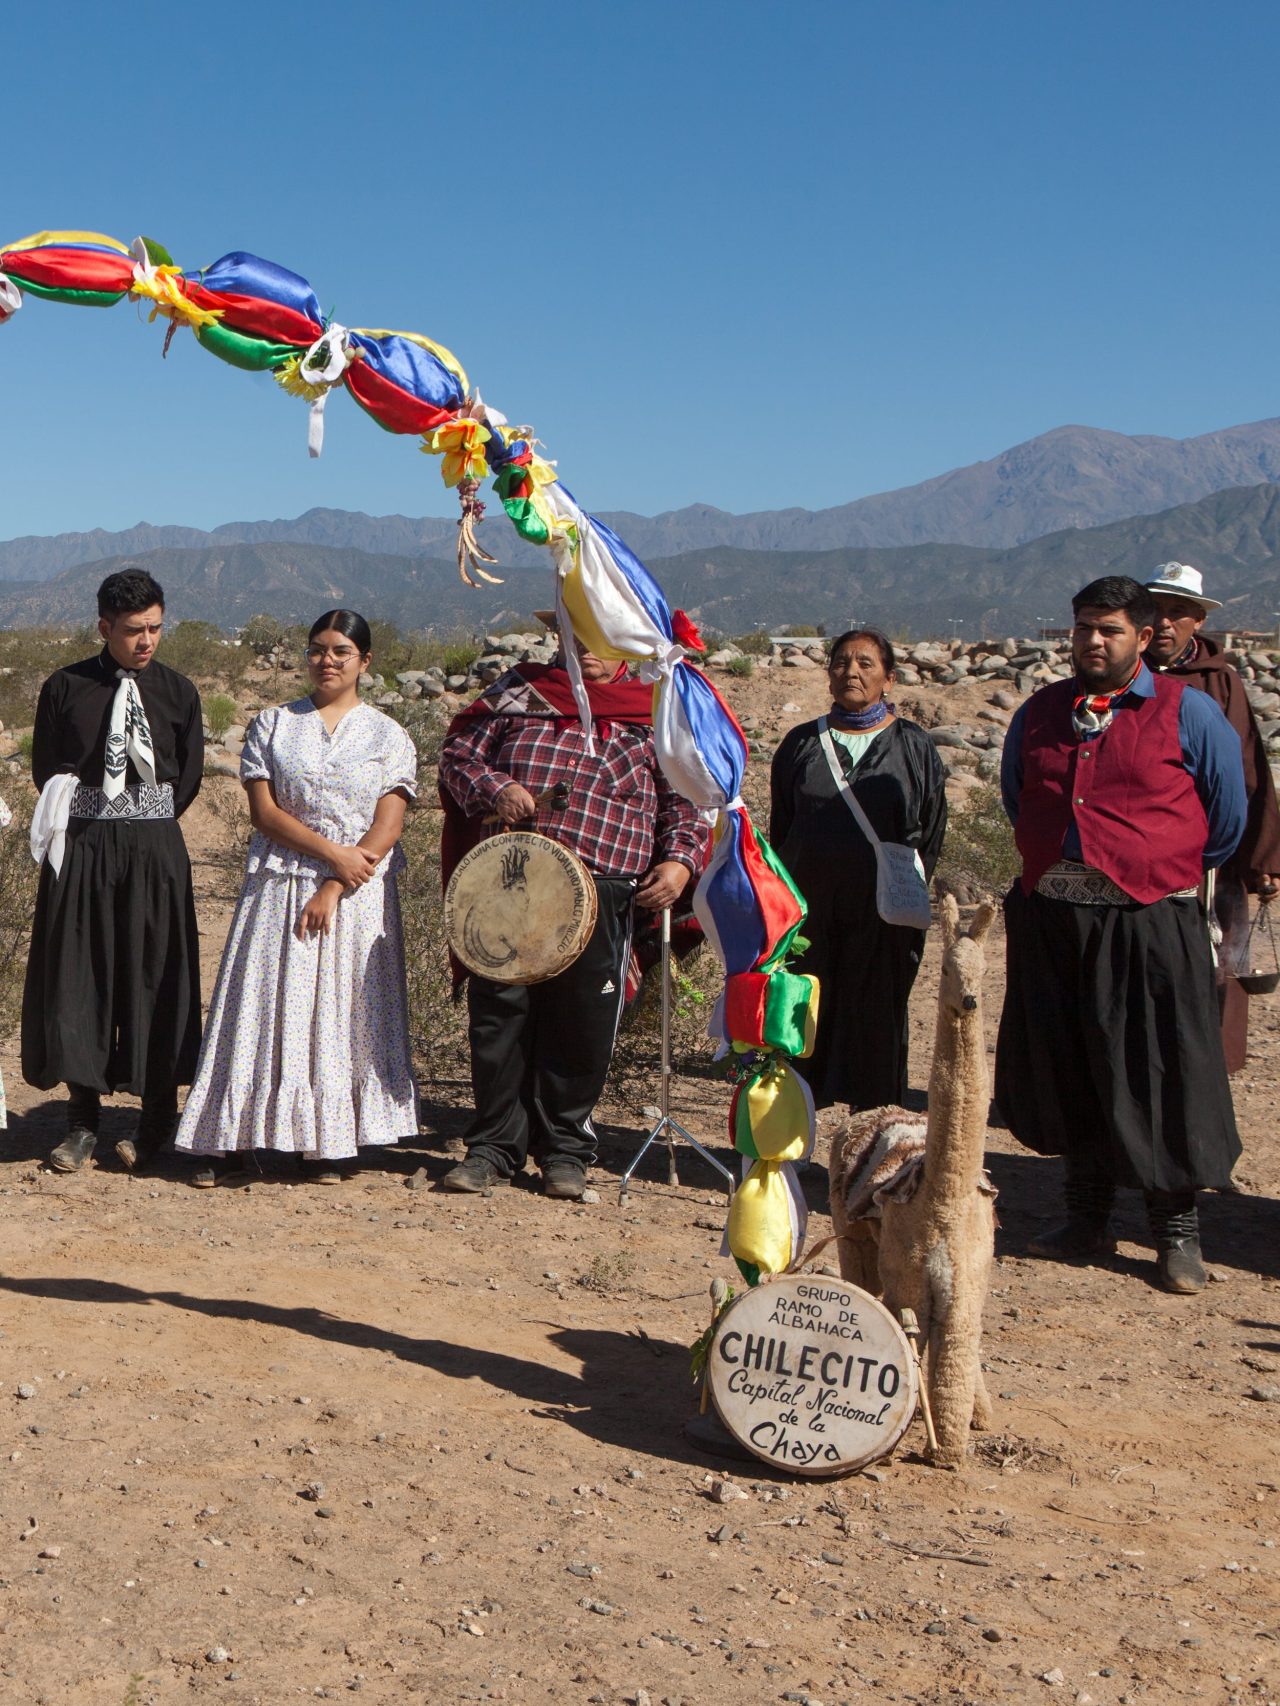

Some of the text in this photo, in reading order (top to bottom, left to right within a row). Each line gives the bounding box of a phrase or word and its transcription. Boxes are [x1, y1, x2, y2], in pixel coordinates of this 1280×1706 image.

[470, 842, 491, 860] LUNA
[492, 835, 511, 847] CON
[514, 835, 551, 850] AFECTO
[551, 845, 581, 886] VIDALERO
[446, 877, 458, 904] AMIGO
[446, 907, 454, 919] EL
[796, 1285, 851, 1307] GRUPO
[775, 1297, 859, 1326] RAMO DE
[768, 1311, 864, 1342] ALBAHACA
[719, 1331, 900, 1398] CHILECITO
[728, 1368, 891, 1426] Capital Nacional
[778, 1409, 826, 1433] de la
[749, 1421, 842, 1466] Chaya
